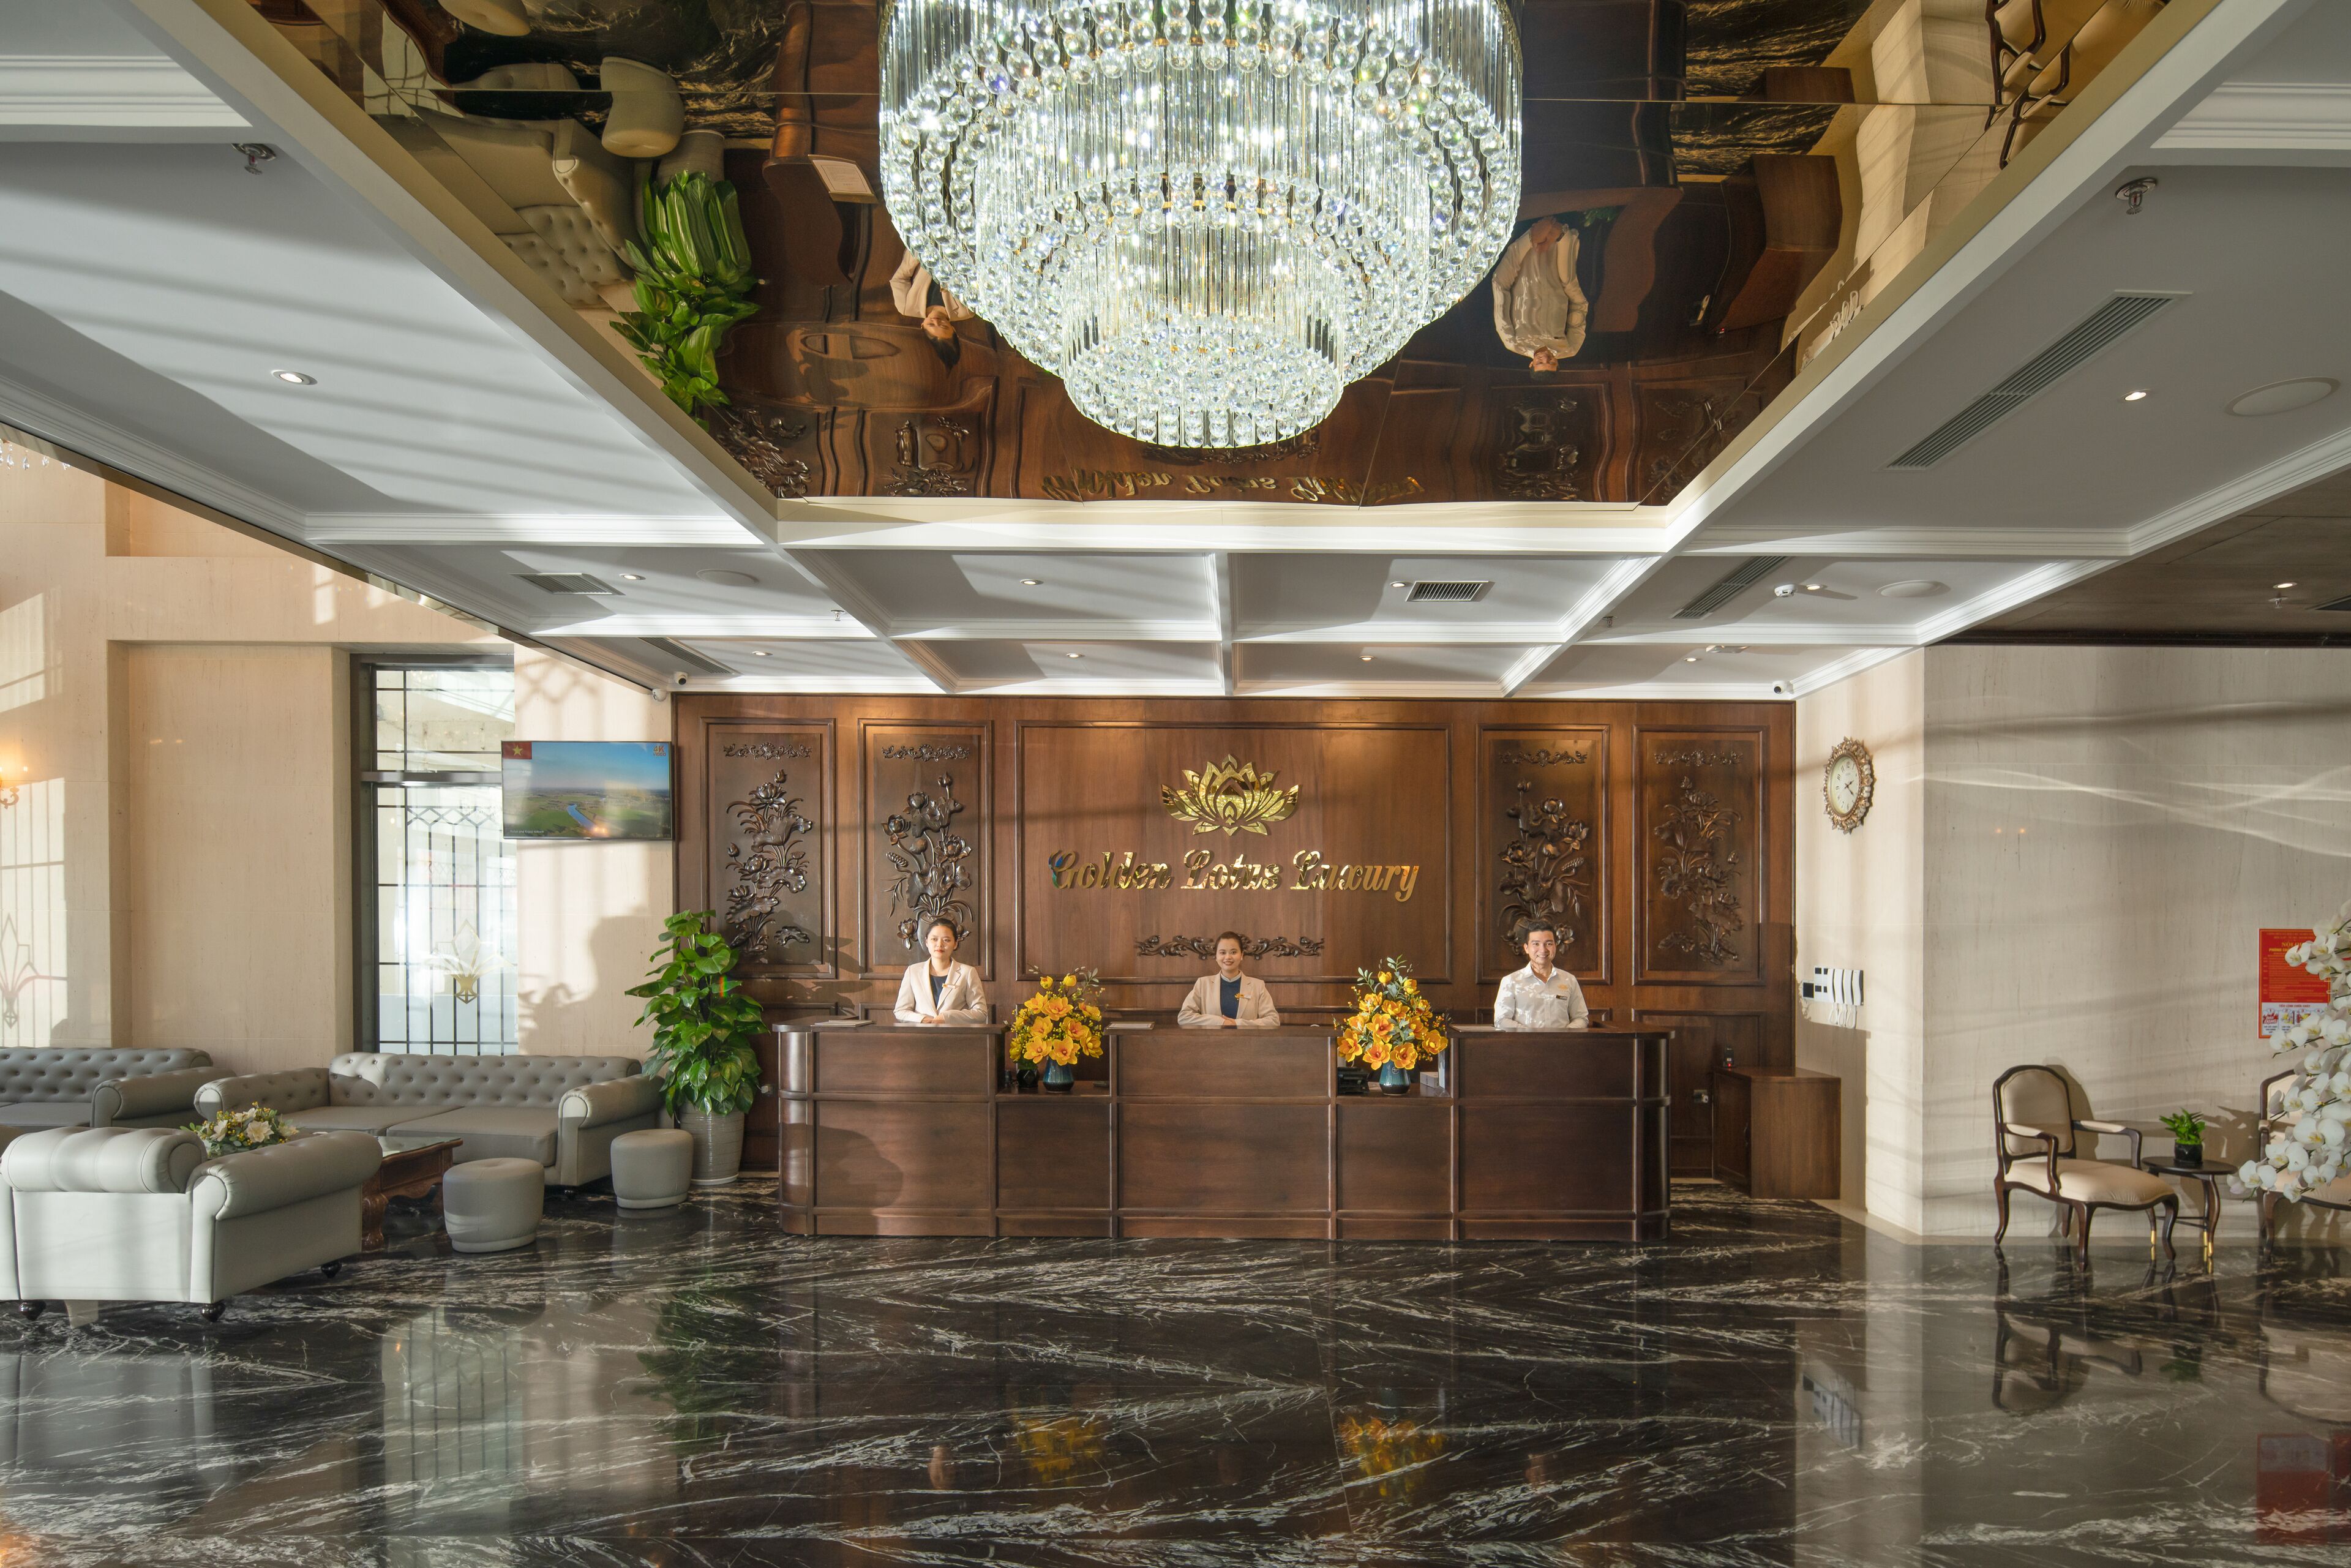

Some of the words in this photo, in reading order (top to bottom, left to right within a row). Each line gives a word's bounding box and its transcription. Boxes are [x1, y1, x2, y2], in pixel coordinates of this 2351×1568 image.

[1048, 850, 1170, 890] Golden
[1180, 849, 1279, 890] Lotus
[1290, 850, 1420, 902] Luxury
